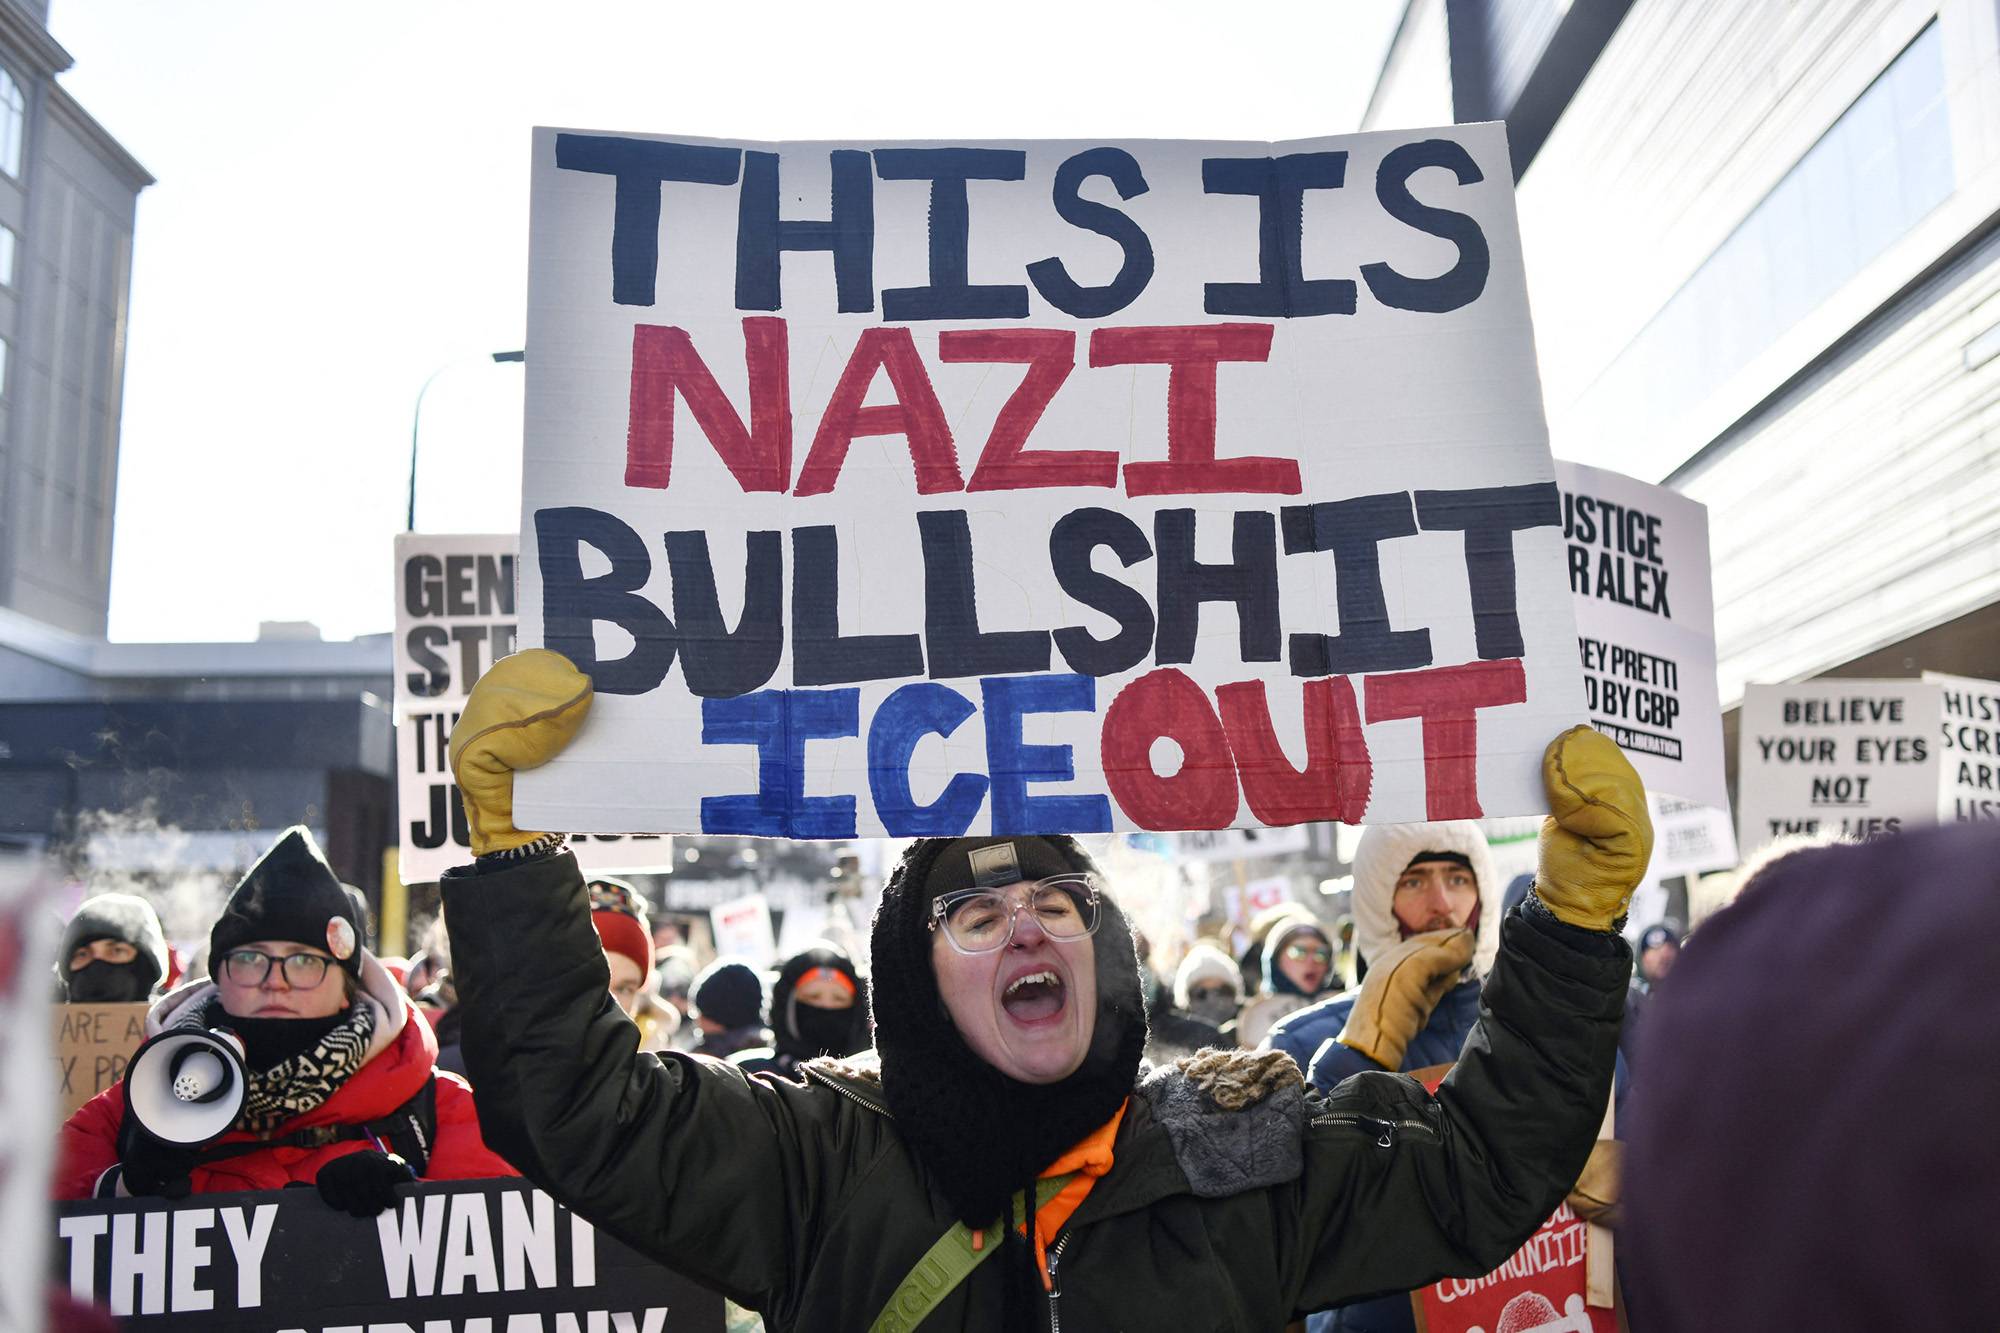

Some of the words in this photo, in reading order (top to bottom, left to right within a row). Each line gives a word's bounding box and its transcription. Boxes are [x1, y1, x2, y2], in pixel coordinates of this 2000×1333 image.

[555, 133, 1155, 322] THIS
[1202, 139, 1490, 319] IS
[625, 316, 1302, 499] NAZI
[533, 482, 1561, 698] BULLSHIT
[1596, 551, 1672, 620] ALEX
[1611, 644, 1679, 691] PRETTI
[1602, 679, 1631, 719] BY
[1635, 687, 1680, 730] CBP
[1783, 698, 1906, 723] BELIEVE
[701, 673, 1112, 838] ICE
[1101, 664, 1526, 832] OUT
[1757, 737, 1836, 763] YOUR
[1856, 737, 1928, 763] EYES
[1811, 777, 1870, 802] NOT
[60, 1012, 112, 1044] ARE
[60, 1204, 279, 1317] THEY
[376, 1188, 597, 1300] WANT
